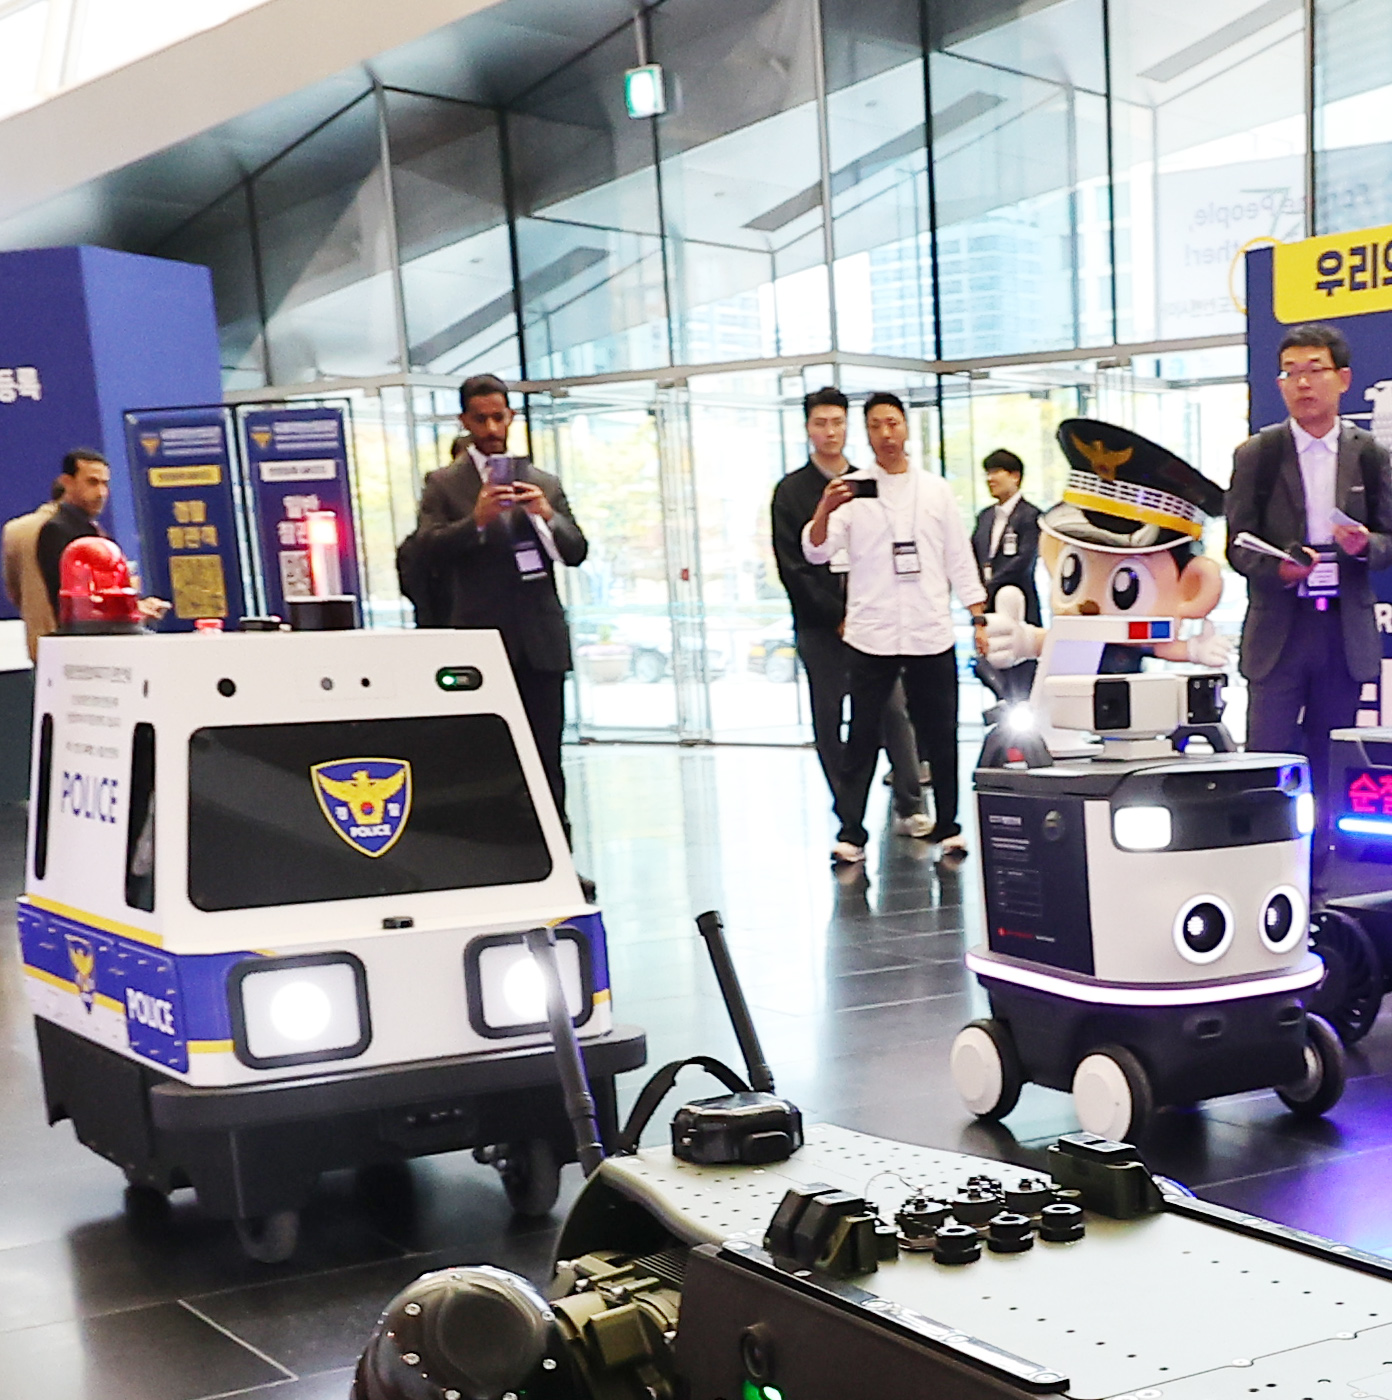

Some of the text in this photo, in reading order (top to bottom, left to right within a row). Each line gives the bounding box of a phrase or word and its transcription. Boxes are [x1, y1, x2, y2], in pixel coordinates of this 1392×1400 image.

[61, 771, 119, 824] POLICE
[349, 823, 392, 838] POLICE
[126, 987, 176, 1036] POLICE
